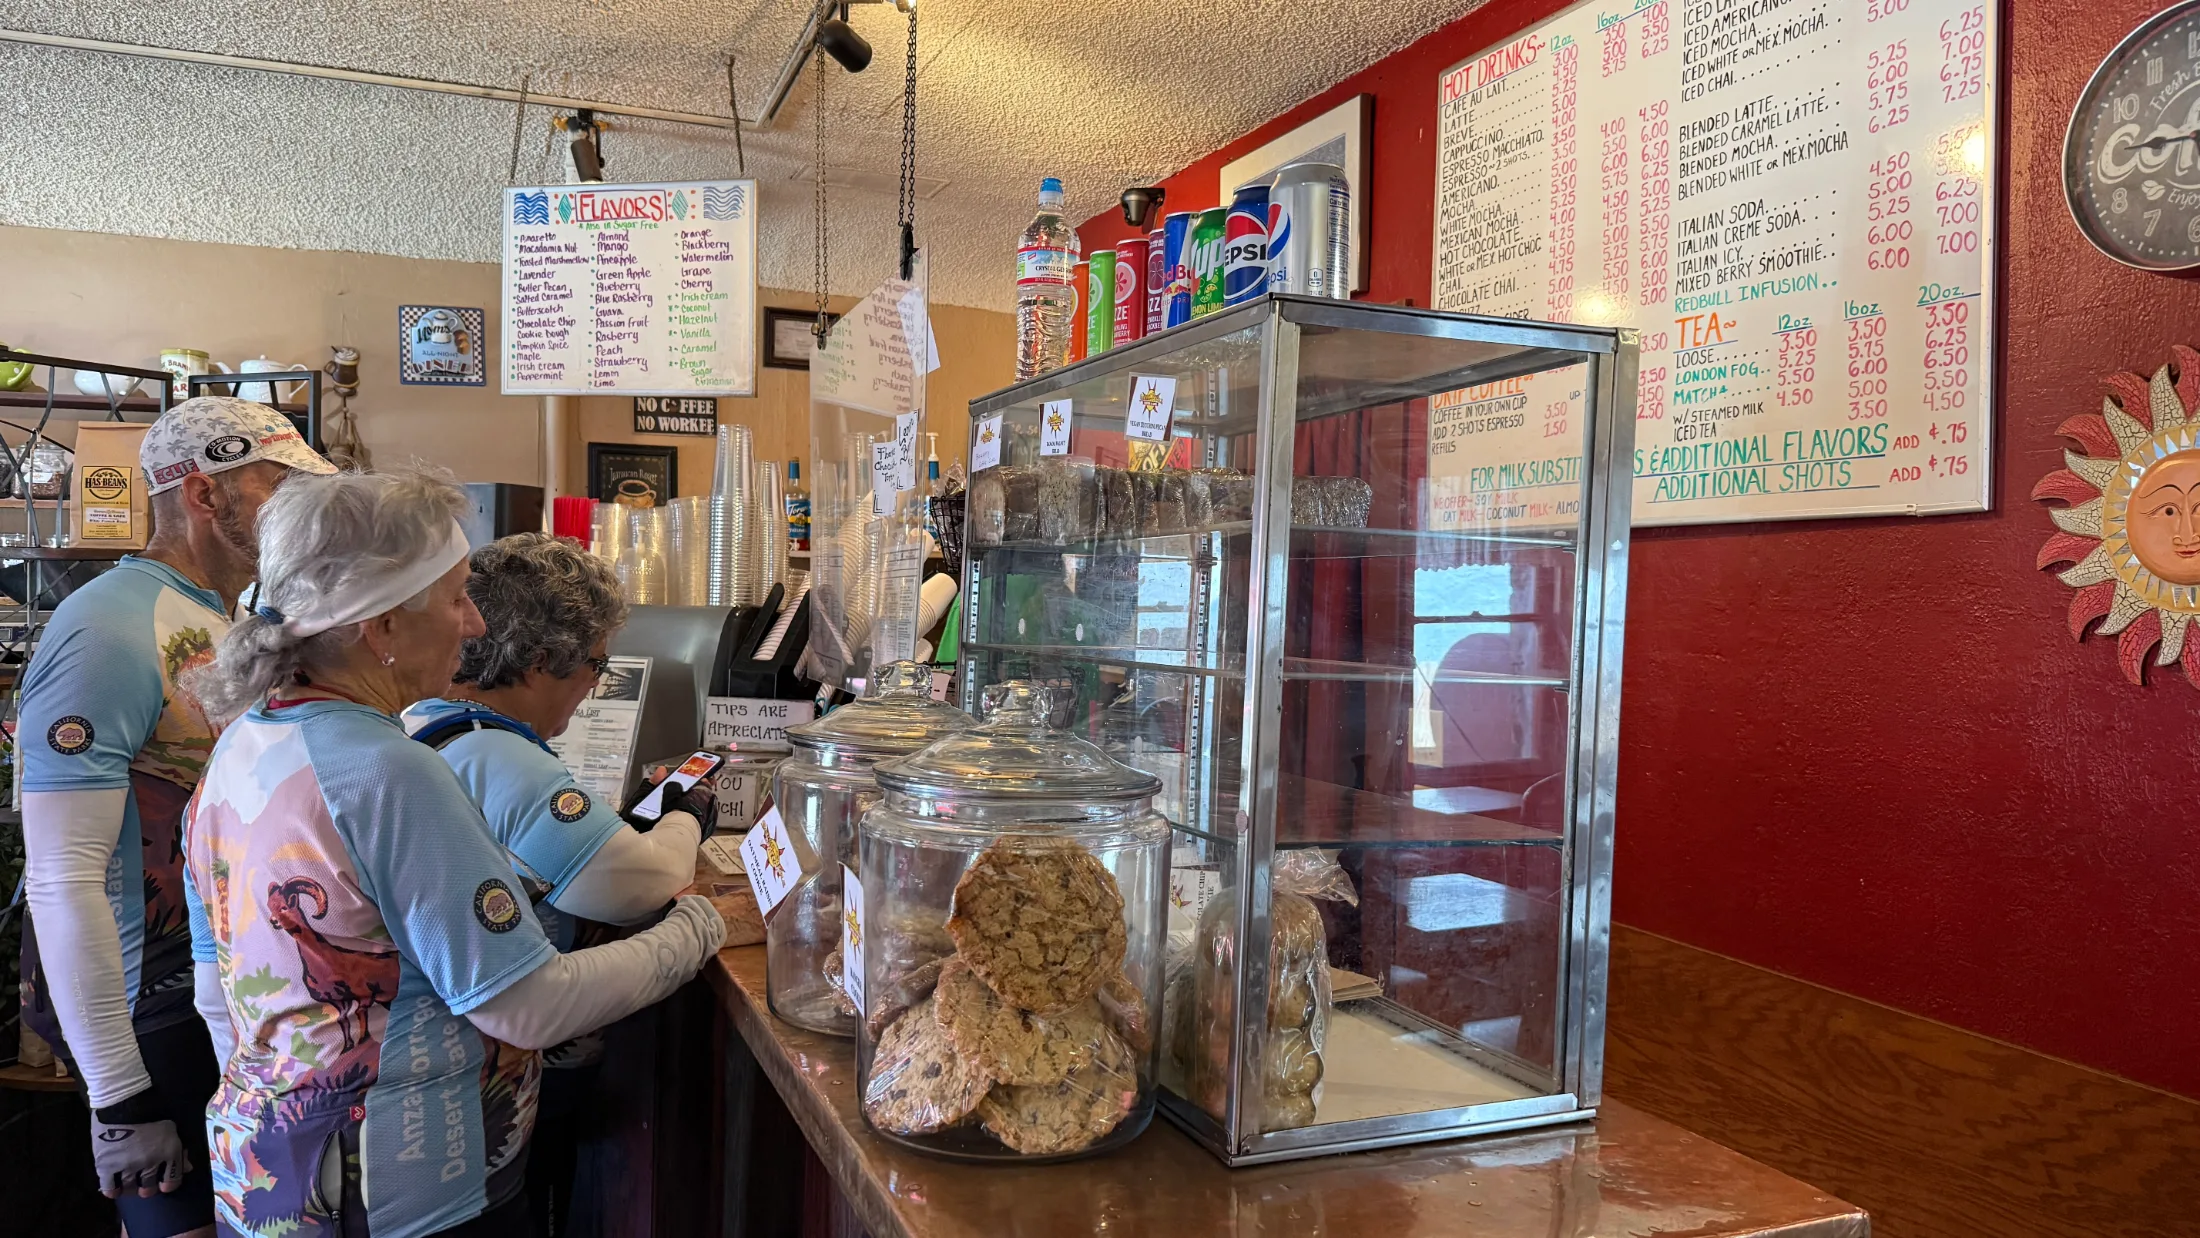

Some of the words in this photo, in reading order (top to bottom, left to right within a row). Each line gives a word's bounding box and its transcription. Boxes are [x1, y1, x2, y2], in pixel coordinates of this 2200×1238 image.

[1939, 5, 1984, 41] 6.25
[1554, 44, 1578, 68] 3.00
[1869, 39, 1907, 70] 5.25
[1941, 31, 1984, 60] 7.00
[1682, 63, 1705, 85] ICED
[1708, 48, 1739, 74] WHITE
[1868, 61, 1908, 89] 6.00
[1444, 65, 1471, 103] HOT
[2113, 93, 2139, 123] 10
[1680, 132, 1728, 160] BLENDED
[1731, 112, 1782, 141] CARAMEL
[1443, 150, 1489, 179] ESPRESSO
[1869, 152, 1910, 176] 4.50
[1678, 171, 1726, 200] BLENDED
[1730, 159, 1762, 183] WHITE
[580, 194, 664, 221] FLAVORS
[2111, 187, 2128, 213] 8
[2143, 209, 2161, 237] 7
[682, 240, 729, 253] Blackberry
[1440, 227, 1482, 250] MEXICAN
[1678, 232, 1717, 257] ITALIAN
[1725, 220, 1761, 244] CREME
[1936, 231, 1977, 254] 7.00
[1225, 244, 1266, 265] EPSI
[1439, 264, 1464, 282] WHITE
[1477, 253, 1495, 270] MEX
[1498, 247, 1515, 263] HOT
[1519, 238, 1541, 257] CHOC
[1440, 250, 1460, 268] HOT
[1549, 257, 1573, 276] 4.75
[682, 279, 712, 292] Cherry
[1675, 273, 1710, 295] MIXED
[1717, 260, 1753, 284] BERRY
[1675, 290, 1732, 313] REDBULL
[1778, 329, 1817, 353] 3.50
[1848, 317, 1886, 341] 3.50
[1926, 302, 1968, 328] 3.50
[597, 345, 622, 355] Peach
[1675, 367, 1727, 385] LONDON
[1778, 349, 1816, 368] 5.25
[1849, 340, 1883, 359] 5.75
[1925, 326, 1967, 347] 6.25
[637, 398, 657, 412] NO
[1512, 397, 1527, 410] CUP
[1544, 402, 1567, 418] 3.50
[1691, 406, 1739, 422] STEAMED
[1743, 402, 1764, 416] MILK
[637, 416, 655, 430] NO
[658, 416, 714, 432] WORKEE
[1543, 420, 1567, 437] 1.50
[1673, 426, 1697, 442] ICED
[1699, 424, 1716, 438] TEA
[163, 461, 195, 479] CLIF
[1471, 467, 1495, 493] FOR
[1499, 463, 1526, 489] MILK
[1783, 423, 1888, 462] FLAVORS
[1893, 435, 1919, 451] ADD
[1654, 473, 1771, 502] ADDITIONAL
[1779, 461, 1851, 492] SHOTS
[1889, 466, 1921, 483] ADD
[711, 703, 748, 716] TIPS
[759, 705, 787, 718] ARE
